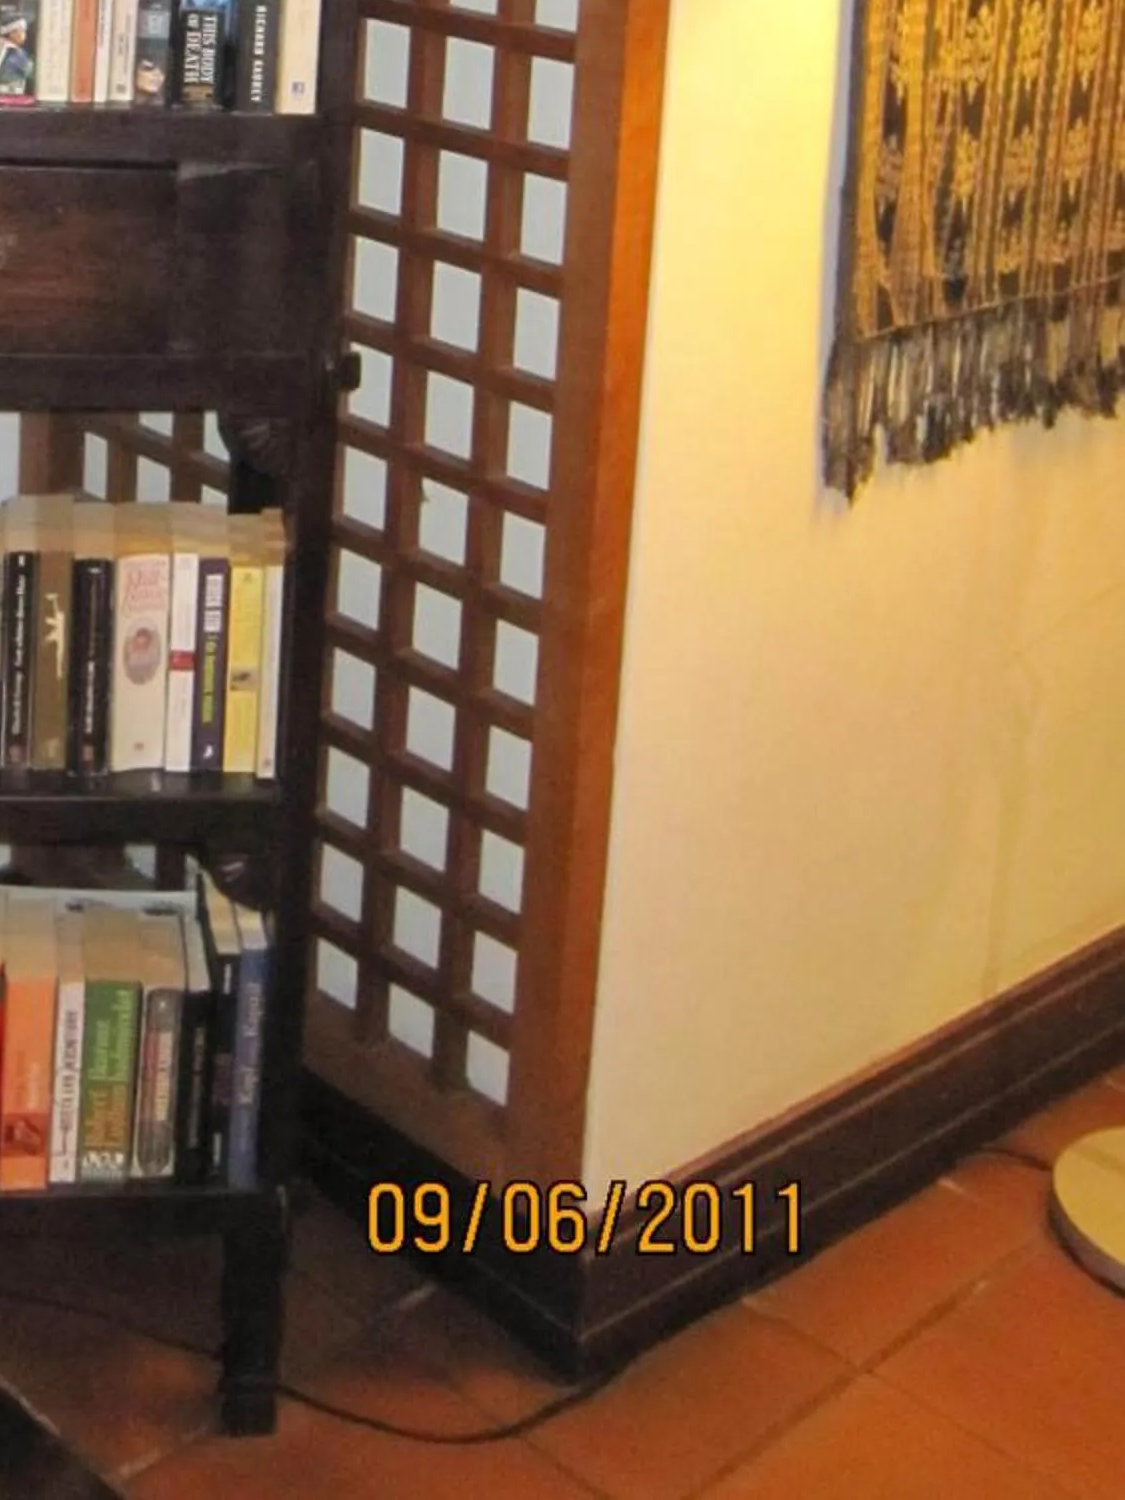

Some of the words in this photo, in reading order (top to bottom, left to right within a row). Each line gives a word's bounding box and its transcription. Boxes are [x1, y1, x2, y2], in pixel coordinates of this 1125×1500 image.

[201, 15, 219, 45] THIS
[253, 5, 268, 55] RICHARD
[183, 31, 202, 84] DEATH
[200, 48, 216, 84] BODY
